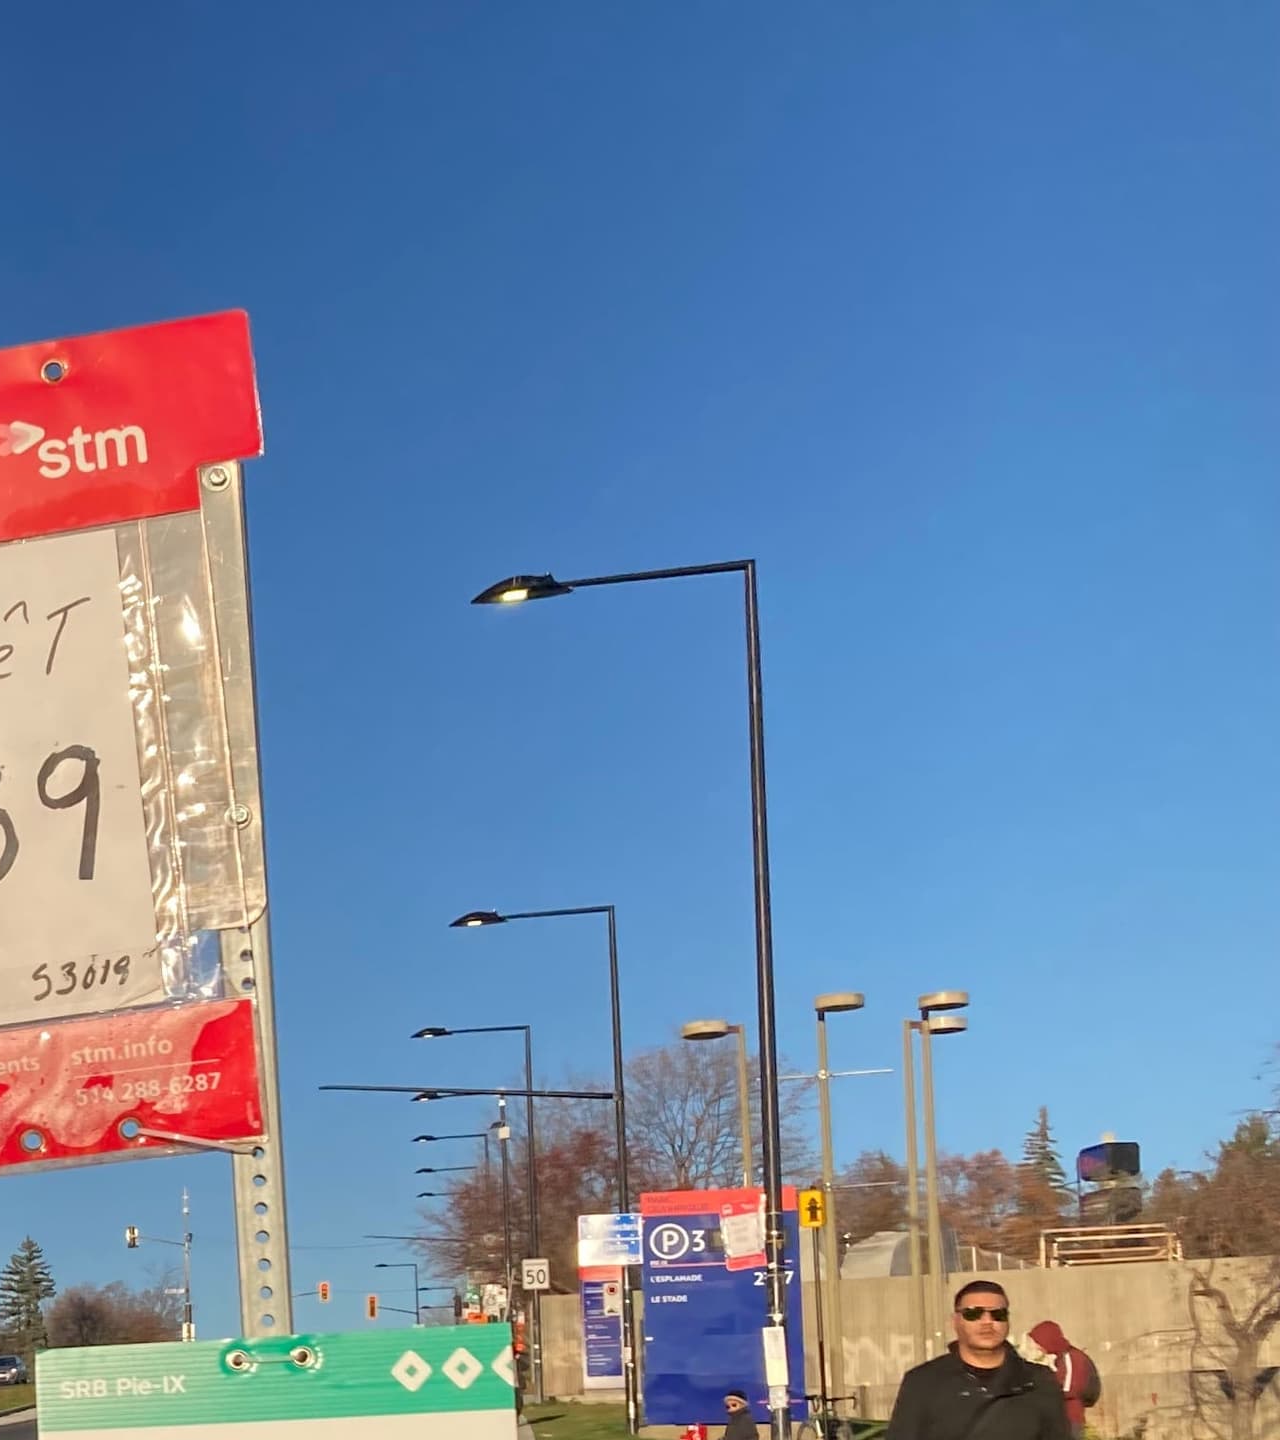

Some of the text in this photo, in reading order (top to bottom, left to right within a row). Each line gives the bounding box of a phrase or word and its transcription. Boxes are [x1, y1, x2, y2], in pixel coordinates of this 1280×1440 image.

[38, 423, 148, 480] stm
[71, 1035, 174, 1066] stm.info
[76, 1072, 222, 1107] 514 288-6287
[691, 1229, 706, 1252] 3
[526, 1269, 546, 1285] 50
[650, 1273, 703, 1284] L'ESPLANADE
[662, 1294, 688, 1303] STADE
[59, 1374, 187, 1400] SRB Pie-IX
